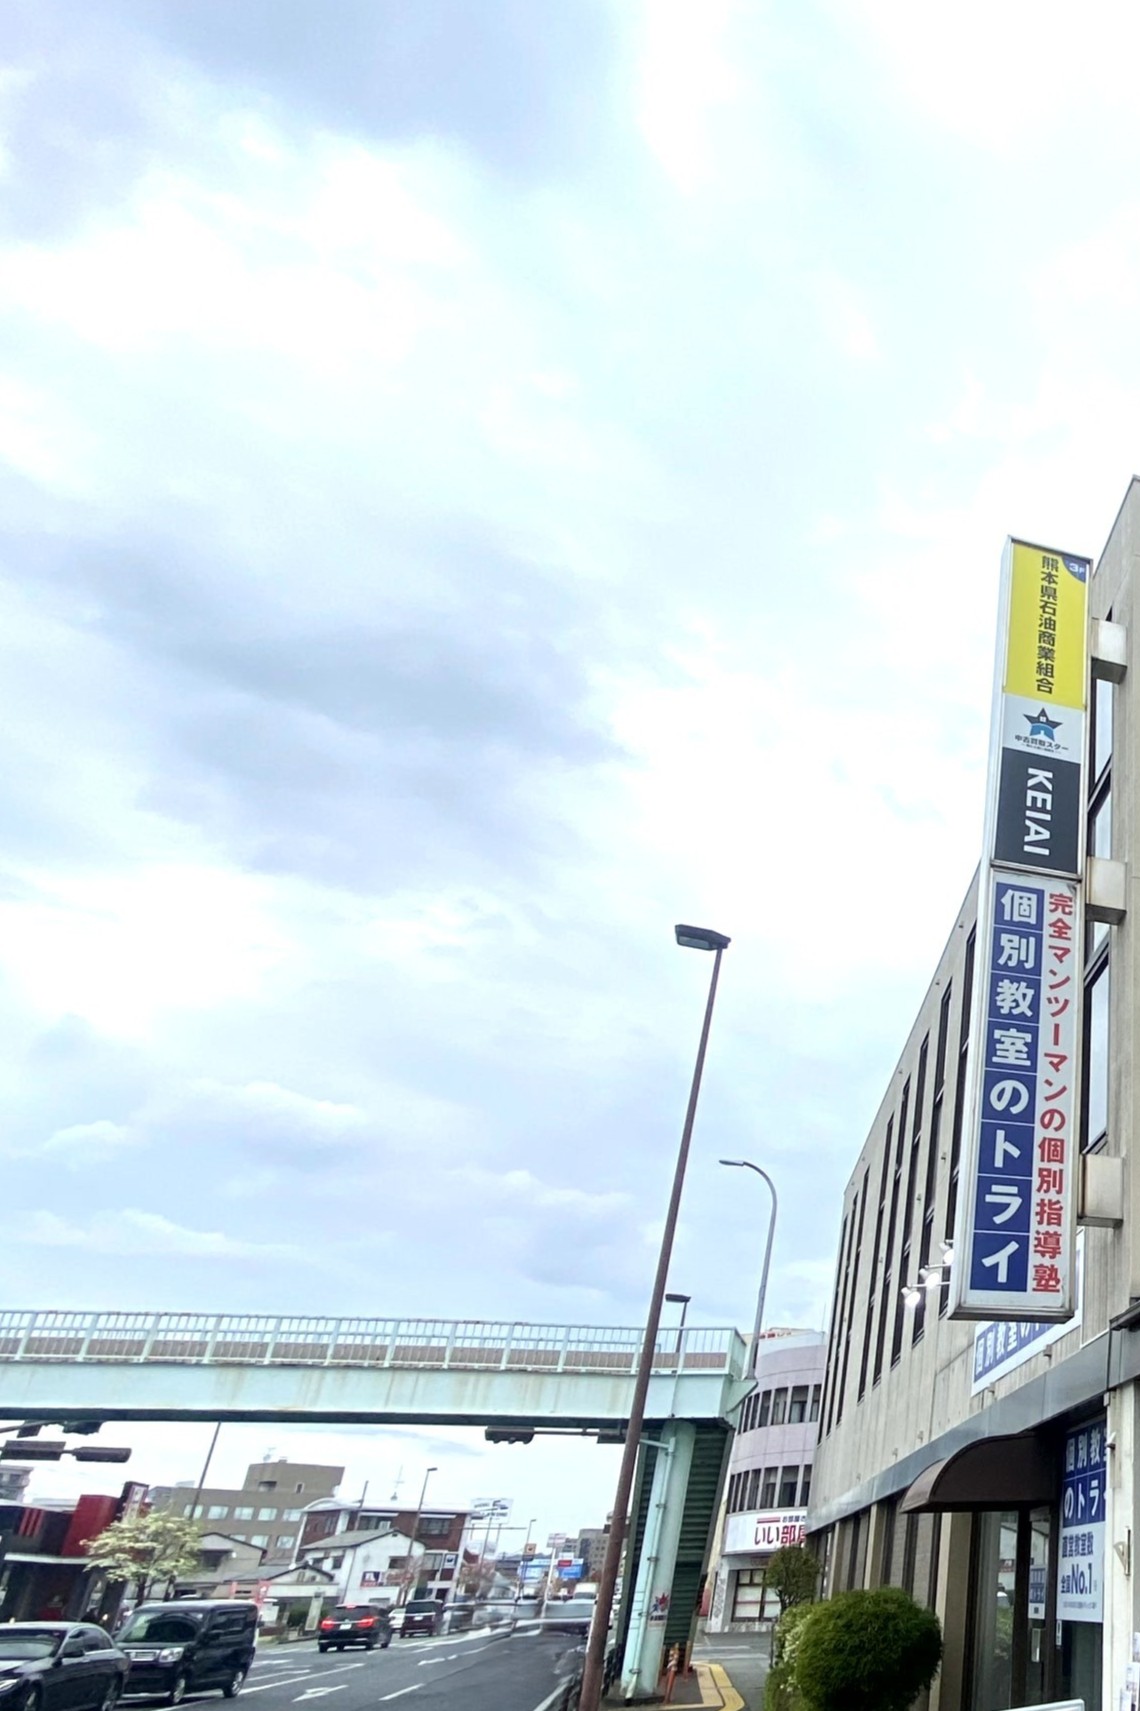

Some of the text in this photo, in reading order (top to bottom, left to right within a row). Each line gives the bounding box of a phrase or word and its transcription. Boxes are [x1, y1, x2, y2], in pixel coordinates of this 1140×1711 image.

[1036, 555, 1059, 695] 熊本県石油商業組合
[1023, 767, 1053, 857] KEIAI
[981, 888, 1039, 1284] 個別教室のトライ
[1031, 892, 1074, 1294] 完全マンツーマンの個別指導塾
[1064, 1479, 1107, 1520] のトラ
[1065, 1426, 1107, 1474] 個別教
